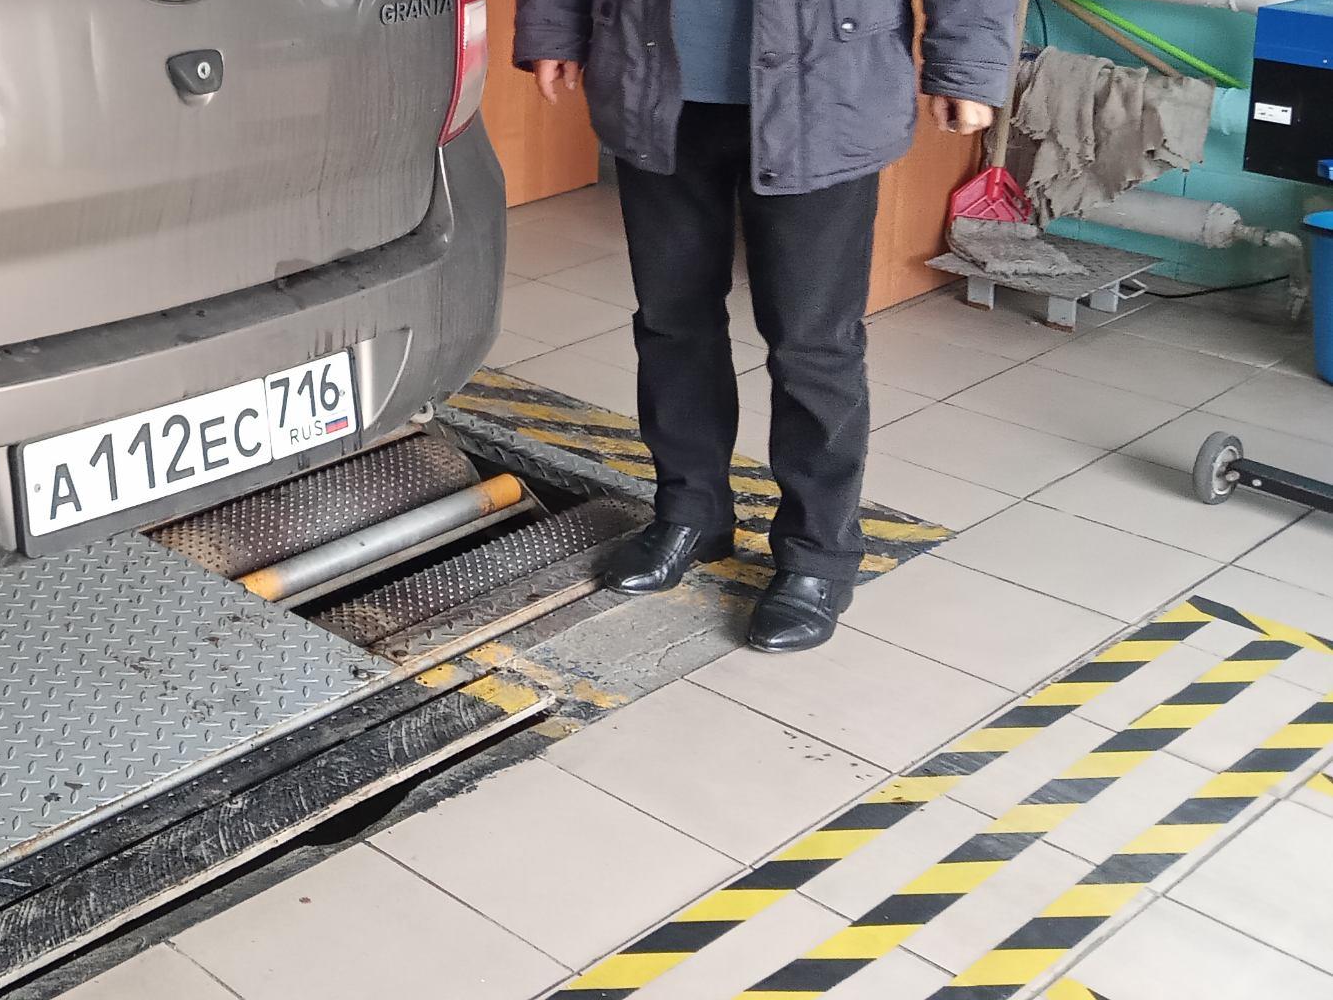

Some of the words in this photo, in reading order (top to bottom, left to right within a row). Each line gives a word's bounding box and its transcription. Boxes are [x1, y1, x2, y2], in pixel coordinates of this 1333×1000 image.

[49, 407, 262, 520] А112ЕС
[269, 363, 340, 429] 716
[289, 417, 324, 446] RUS
